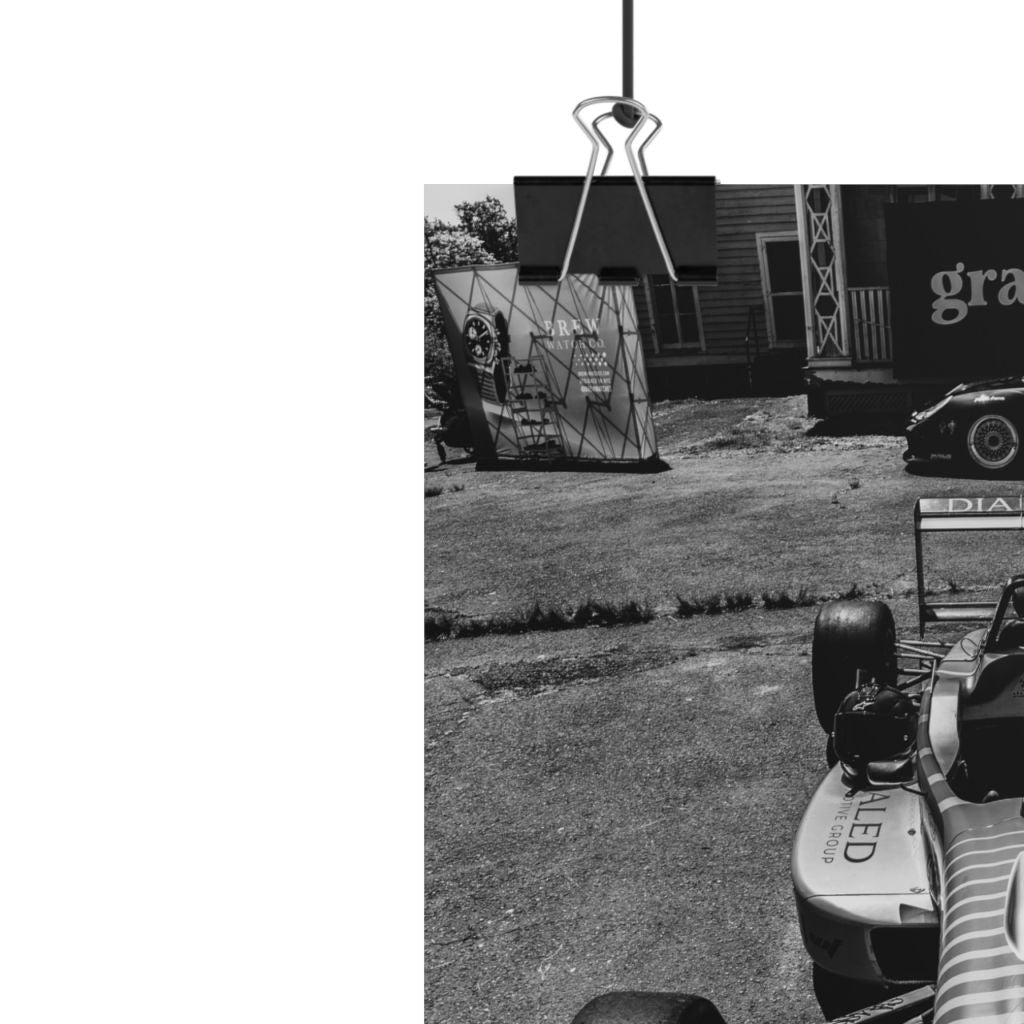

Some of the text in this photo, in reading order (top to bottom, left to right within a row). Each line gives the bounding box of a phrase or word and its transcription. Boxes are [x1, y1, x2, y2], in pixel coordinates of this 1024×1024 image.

[543, 318, 600, 337] BREW
[821, 824, 844, 864] GROUP
[842, 793, 891, 863] ALED
